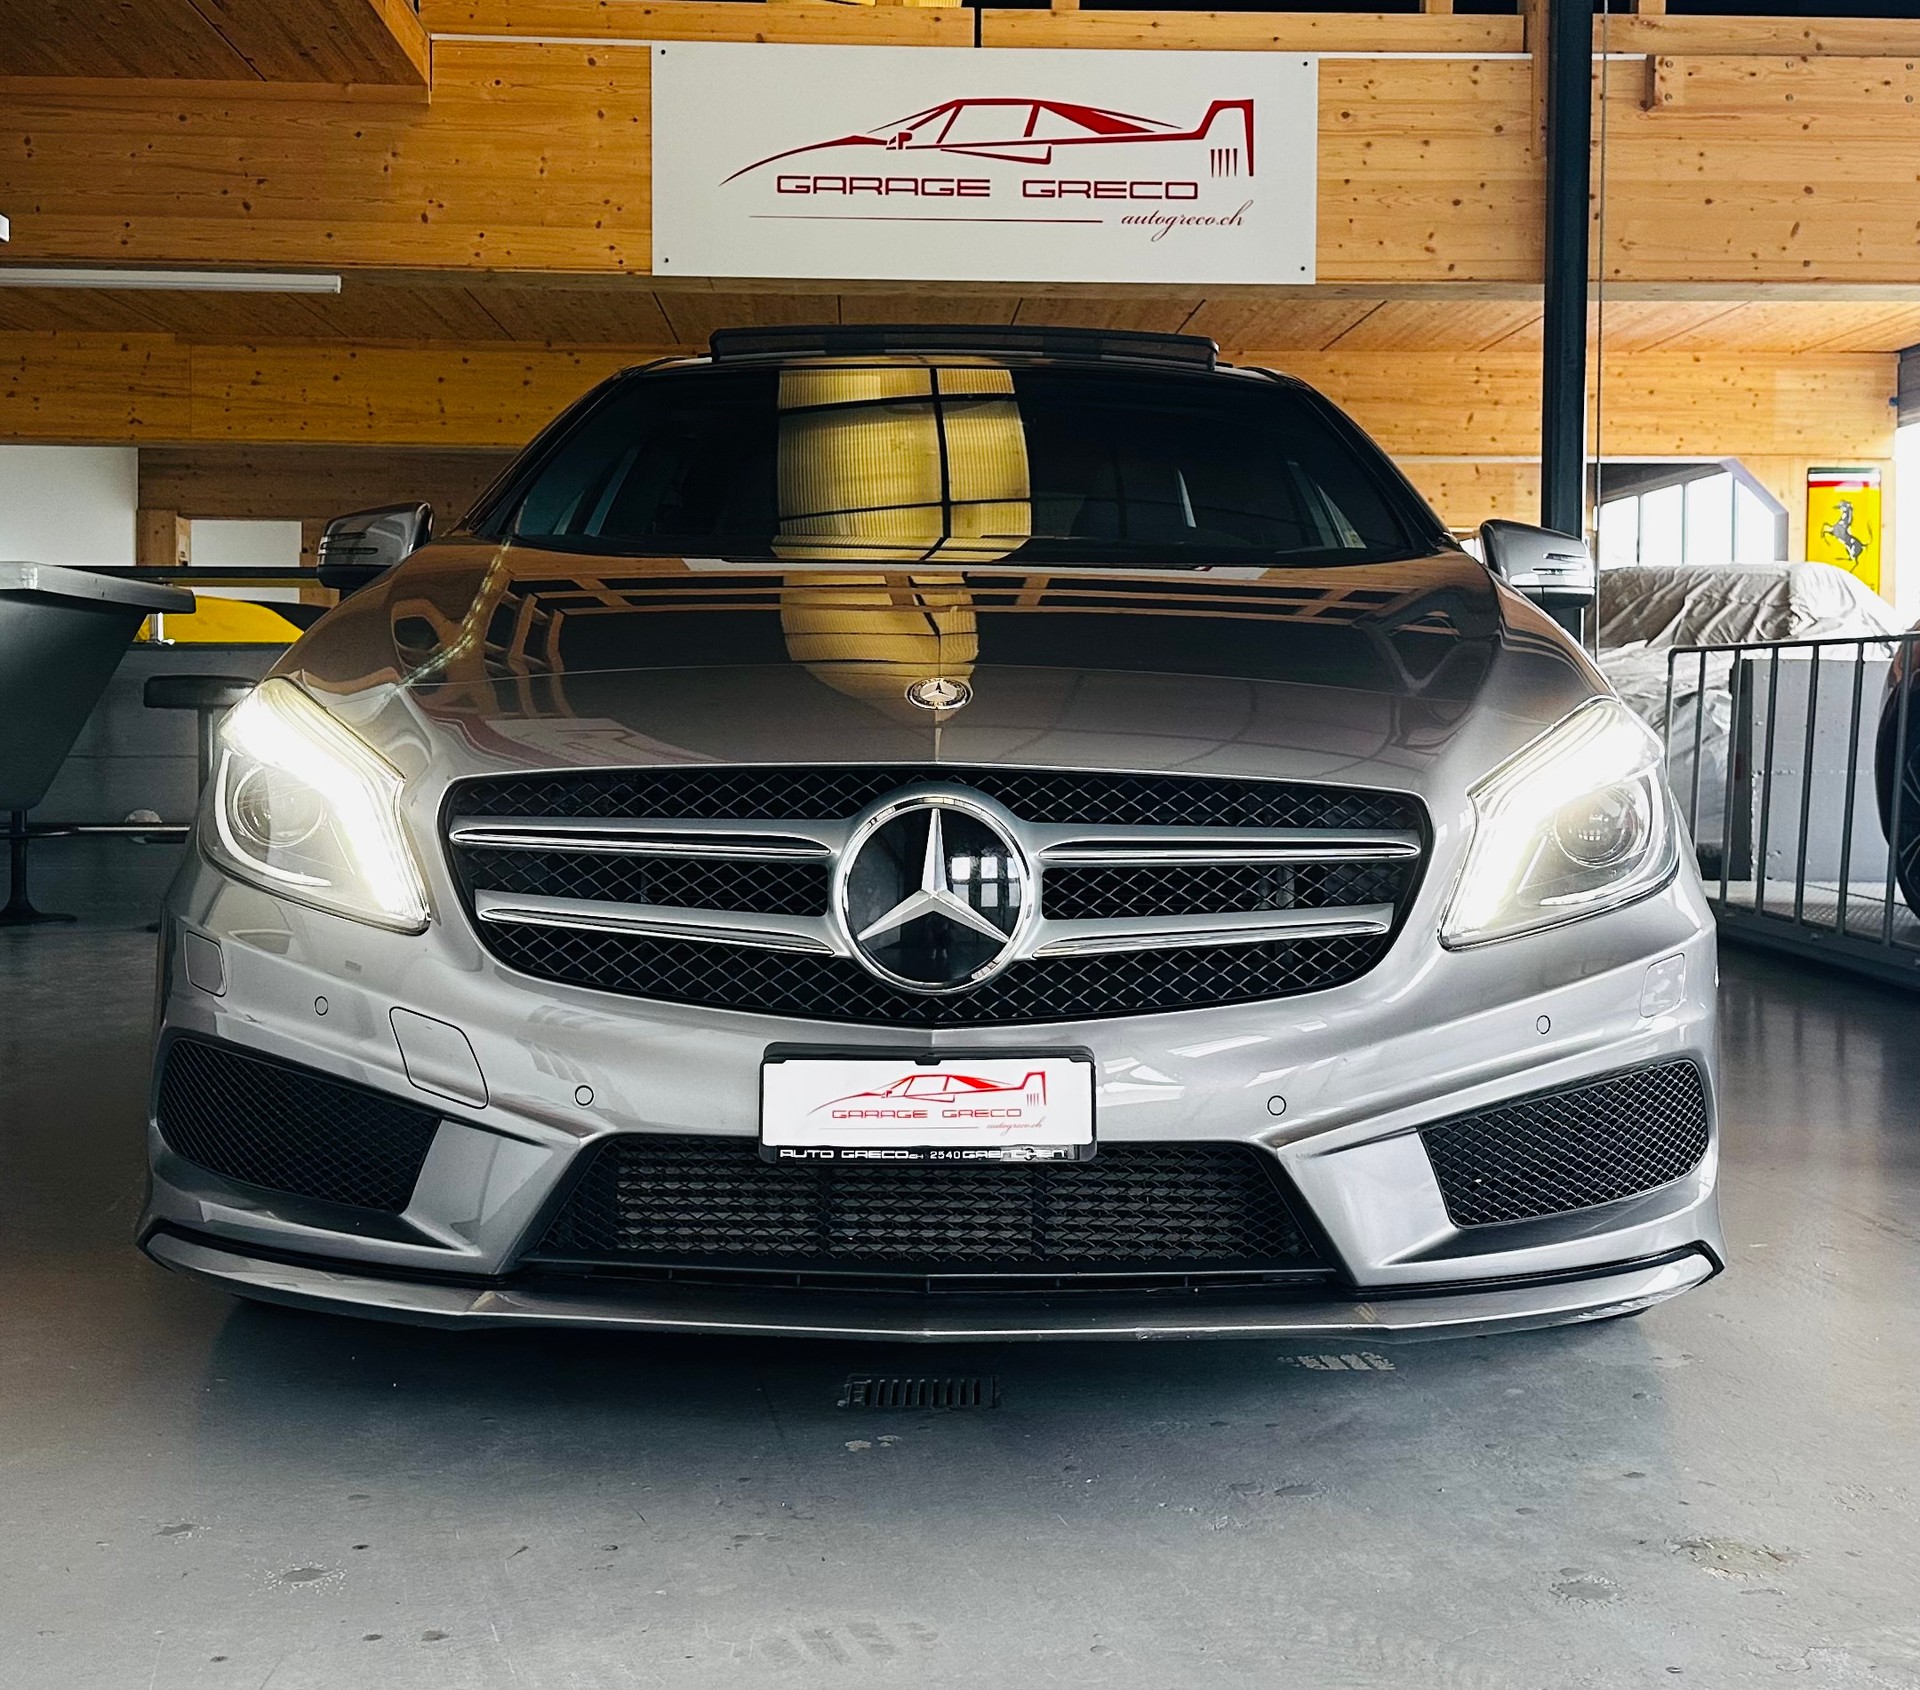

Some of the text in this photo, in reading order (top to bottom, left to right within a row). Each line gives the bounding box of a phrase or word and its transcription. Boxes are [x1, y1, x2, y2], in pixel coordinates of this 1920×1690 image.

[776, 174, 1199, 200] GARAGE GRECO
[1121, 199, 1255, 242] autogreco.ch
[832, 1108, 1022, 1119] GARAGE GRECO
[779, 1149, 835, 1159] AUTO
[929, 1150, 961, 1160] 2540
